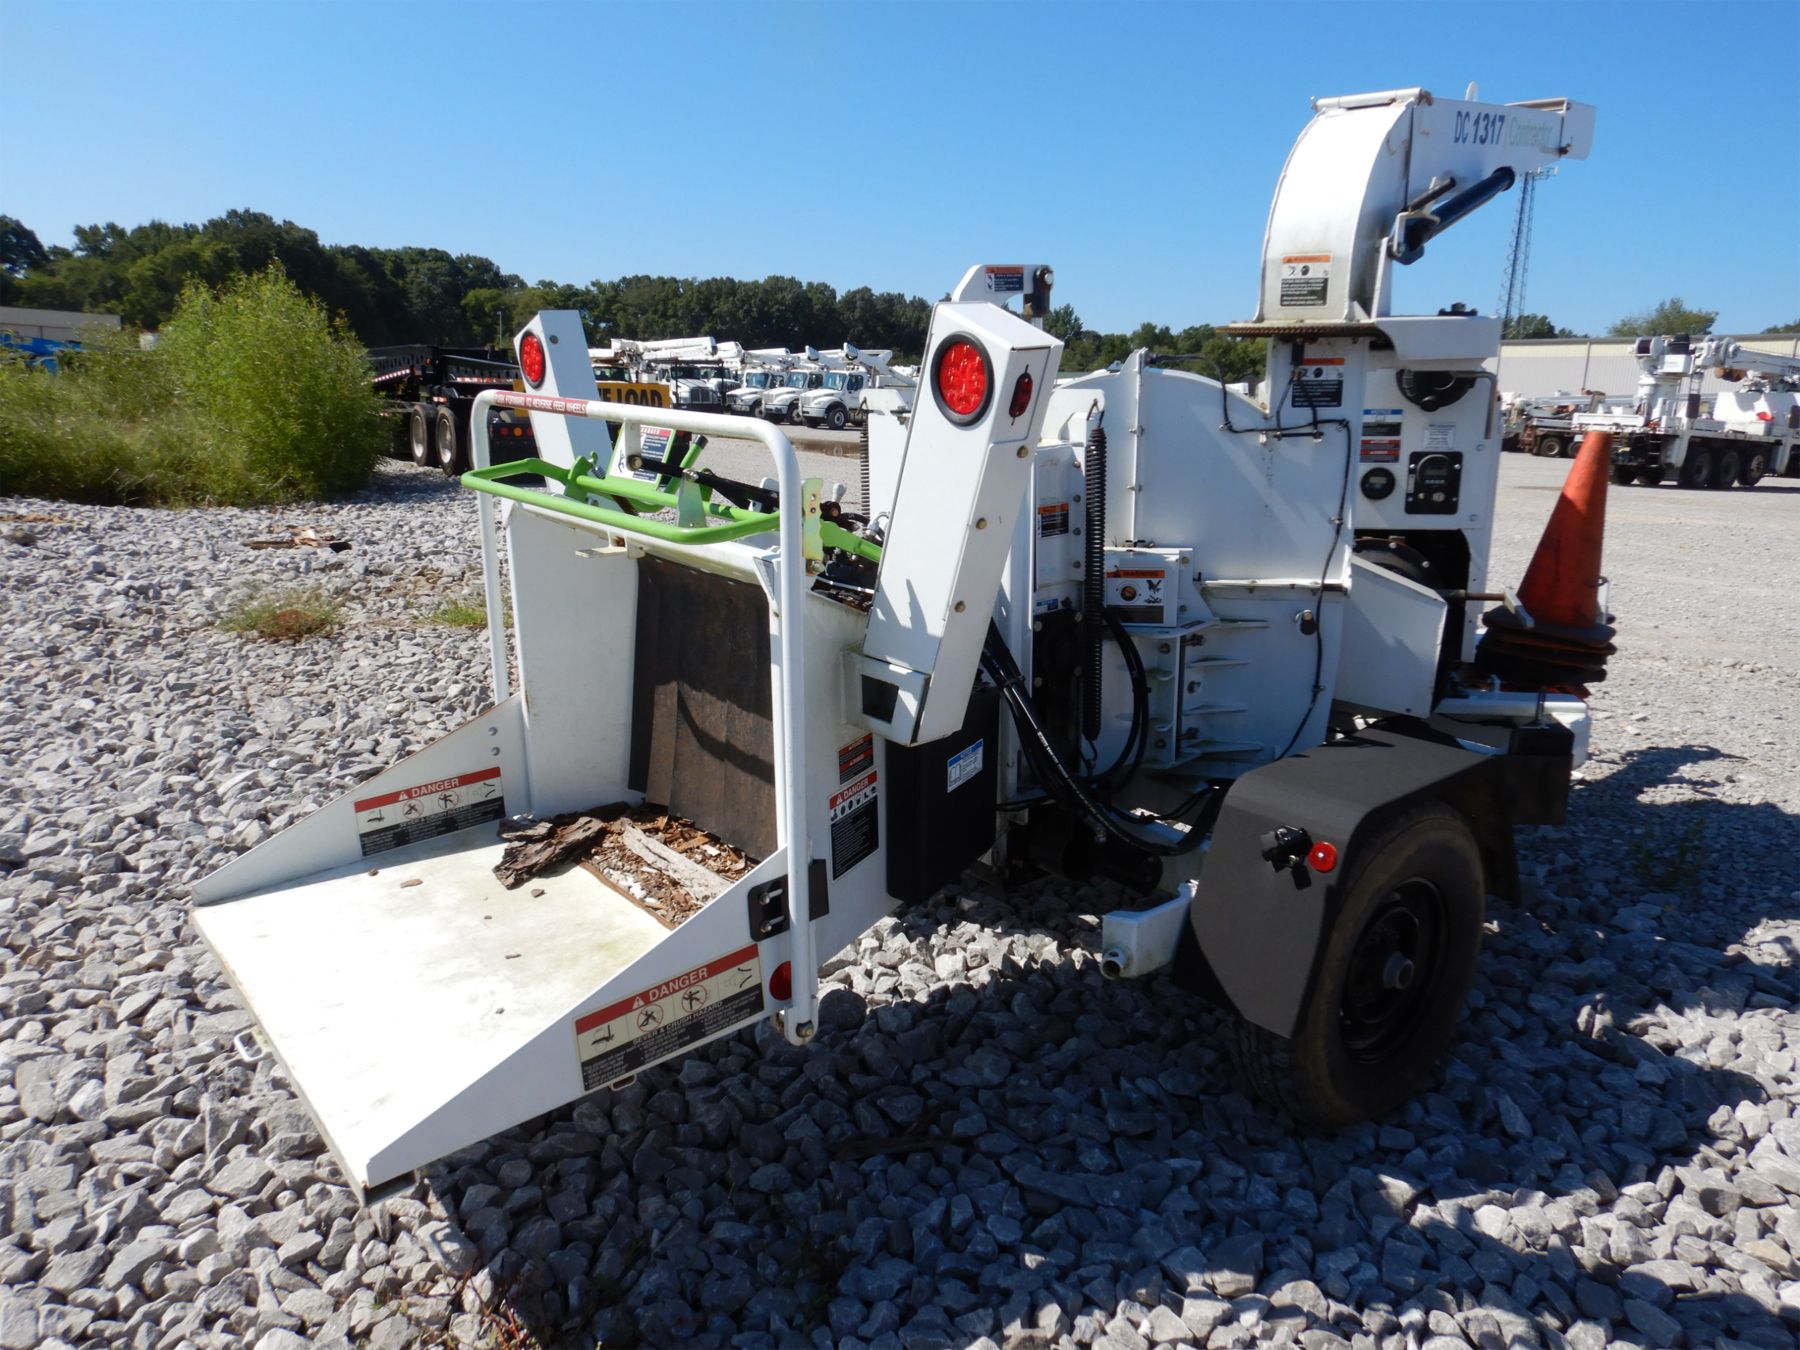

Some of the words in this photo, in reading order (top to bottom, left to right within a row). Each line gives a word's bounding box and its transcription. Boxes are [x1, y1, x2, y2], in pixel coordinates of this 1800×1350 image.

[1454, 110, 1470, 144] DC
[1473, 112, 1505, 145] 1317
[532, 398, 553, 410] REVERSE
[553, 400, 566, 411] FEED
[566, 402, 585, 414] WHEELS
[411, 778, 460, 798] DANGER
[843, 776, 869, 799] DANGER
[650, 967, 708, 1002] DANGER
[666, 1014, 692, 1031] CRUSH
[693, 1000, 723, 1018] HAZARD
